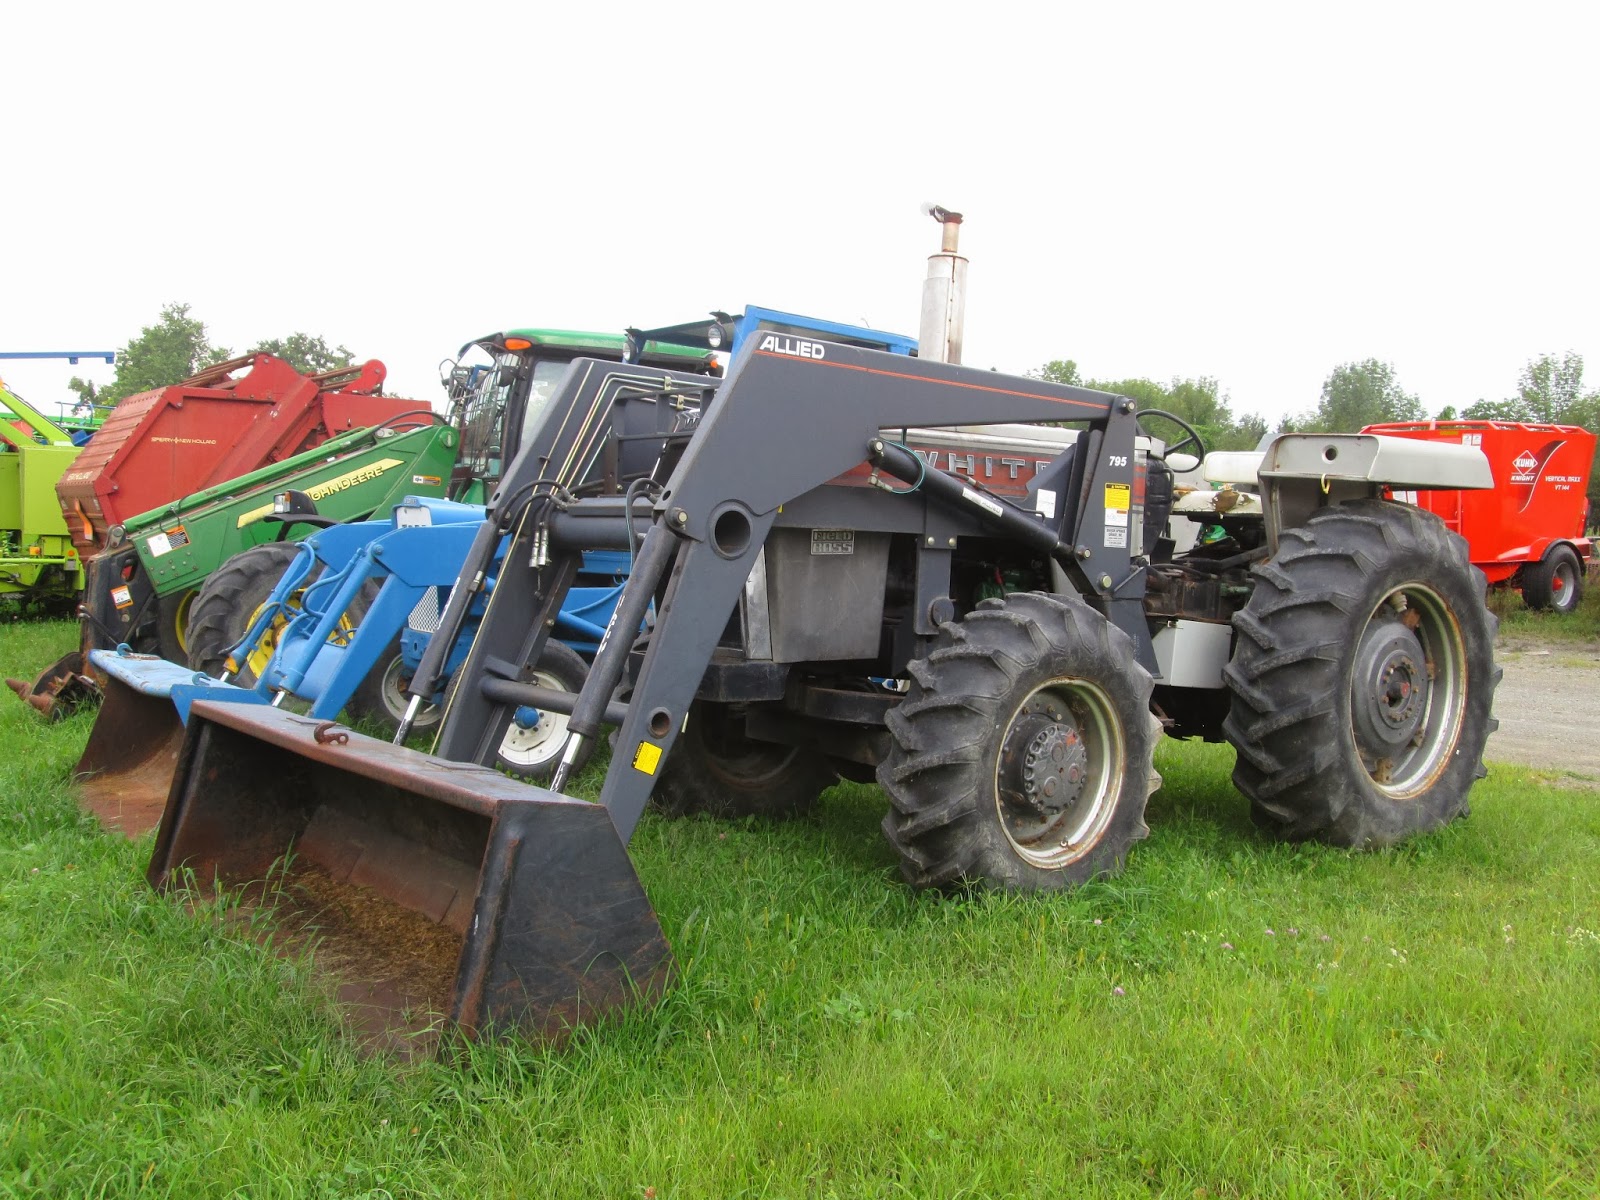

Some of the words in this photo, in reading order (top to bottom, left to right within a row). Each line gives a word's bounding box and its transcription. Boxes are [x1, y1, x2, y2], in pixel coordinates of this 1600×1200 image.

[759, 336, 825, 360] ALLIED
[1109, 455, 1128, 467] 795
[1516, 458, 1535, 468] KUHN
[341, 466, 384, 490] DEERE
[812, 542, 852, 553] BOSS
